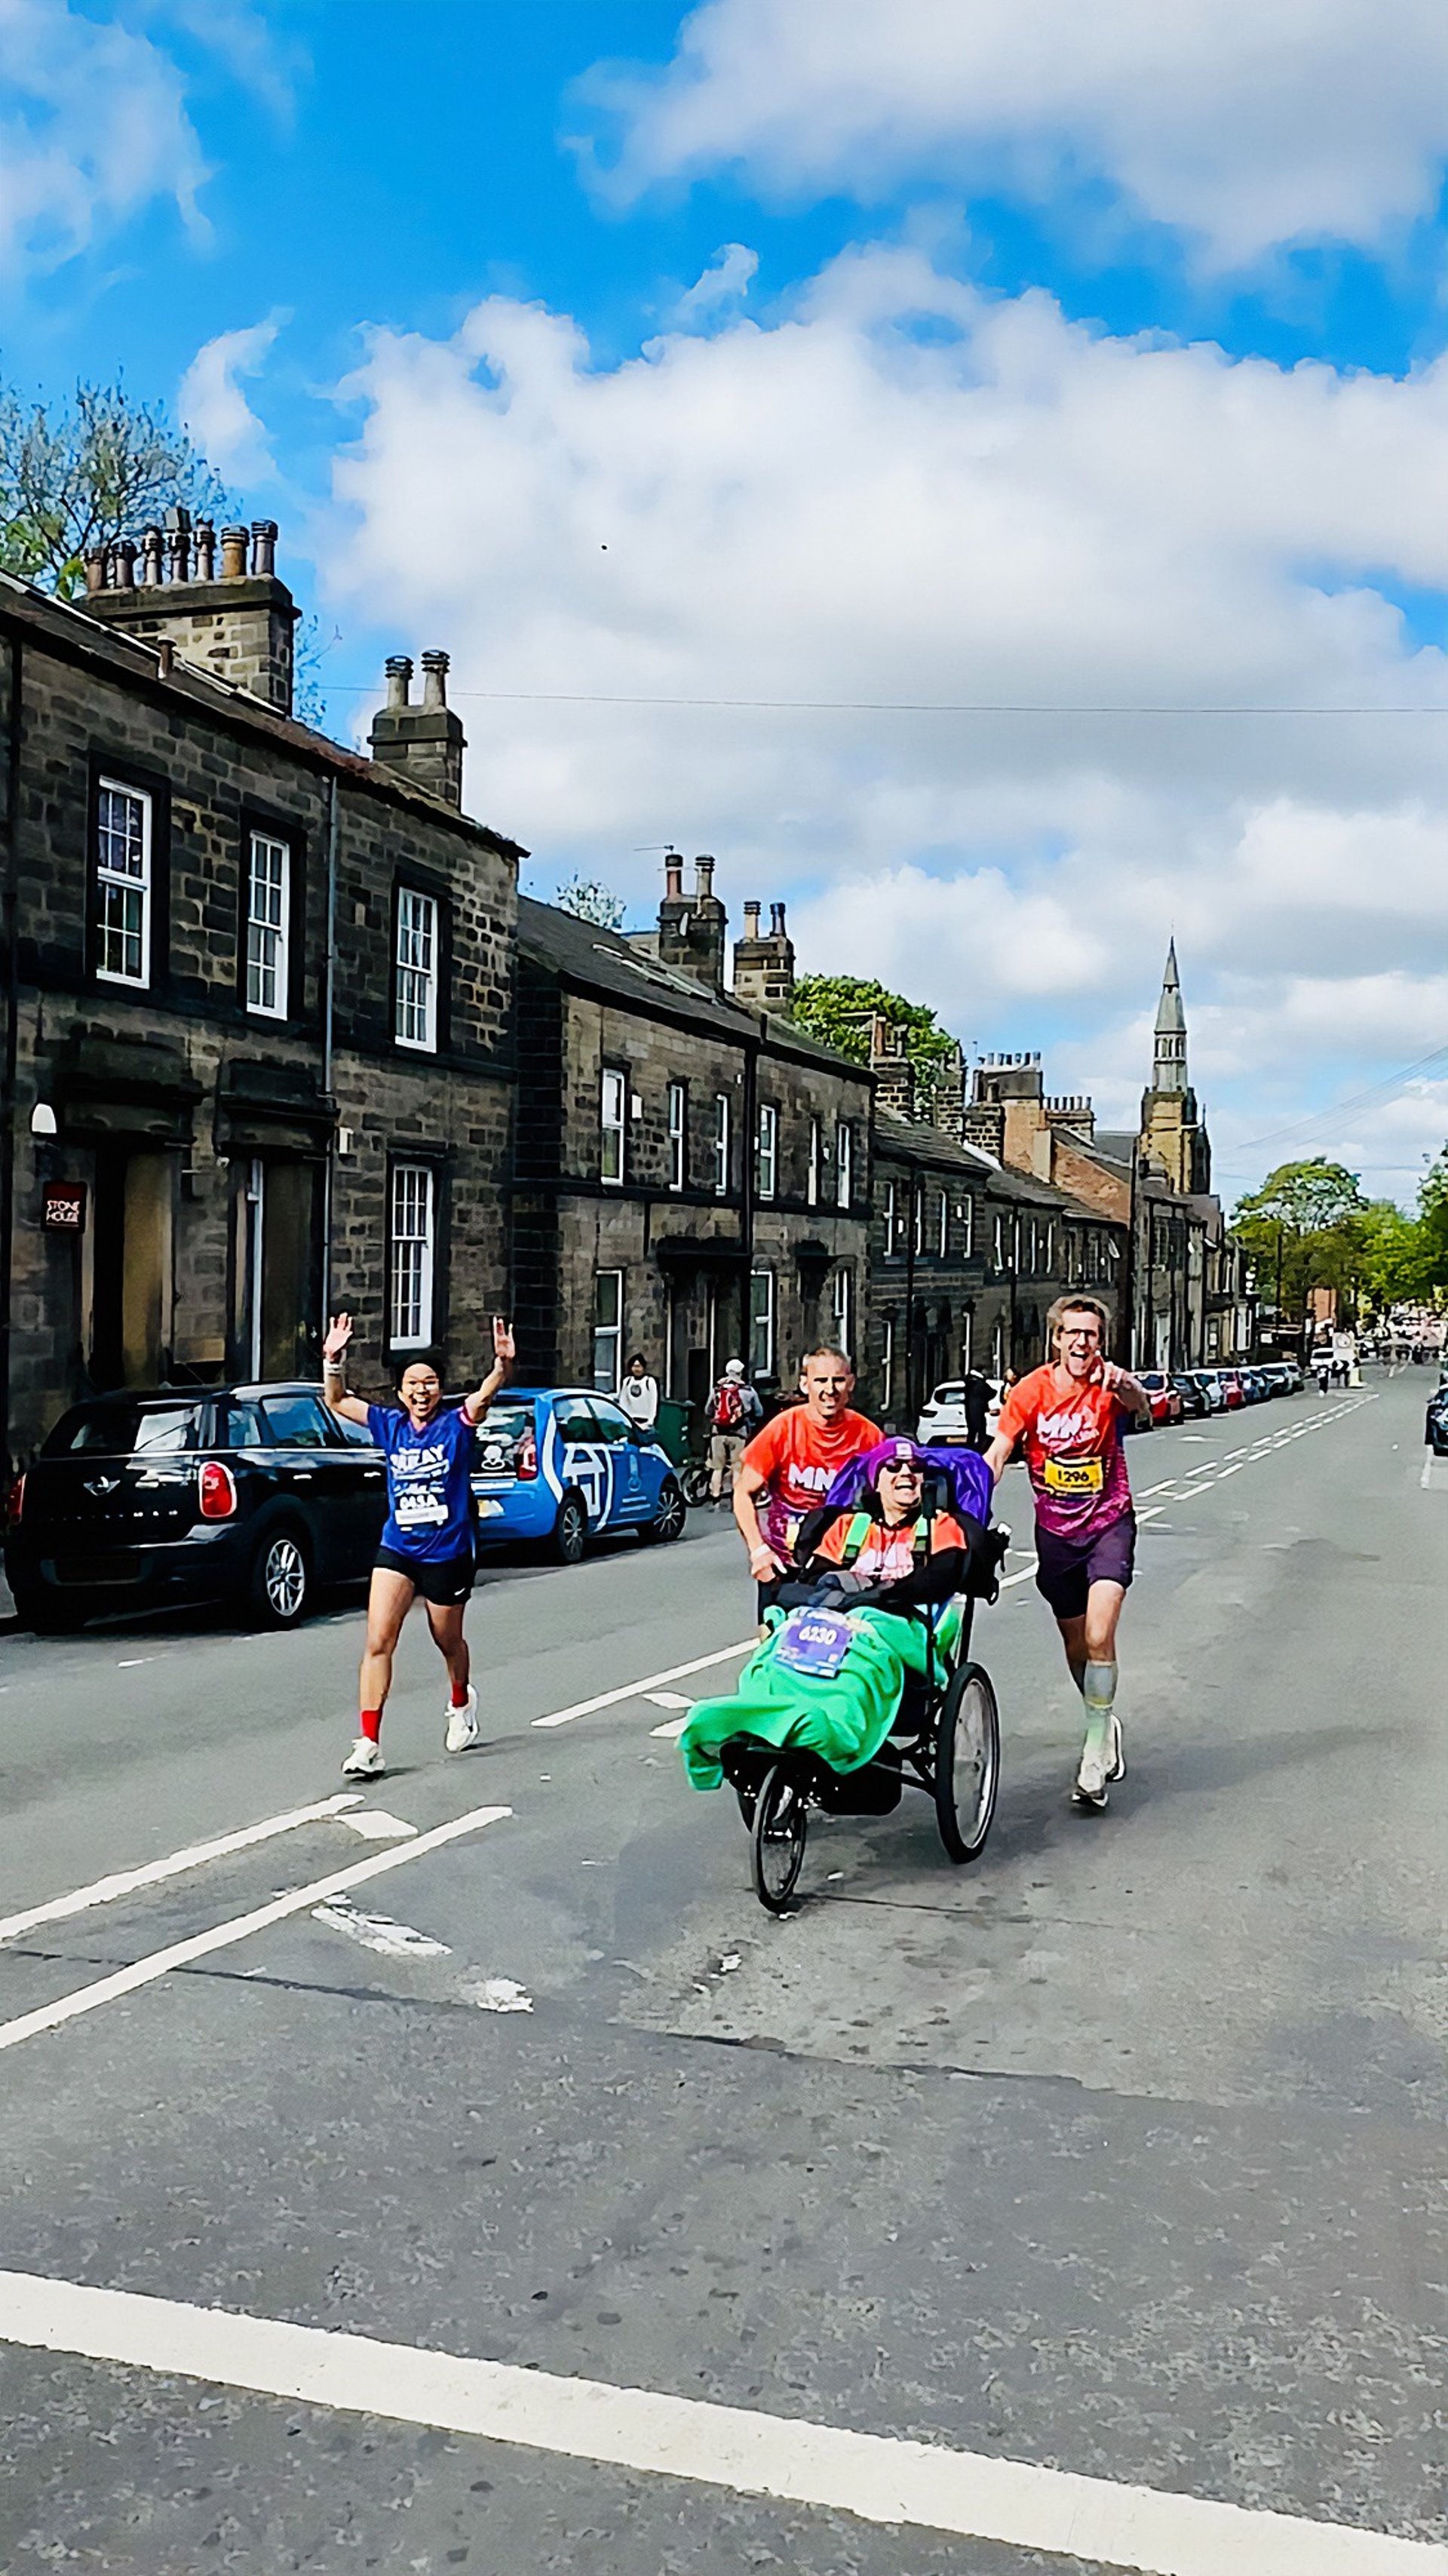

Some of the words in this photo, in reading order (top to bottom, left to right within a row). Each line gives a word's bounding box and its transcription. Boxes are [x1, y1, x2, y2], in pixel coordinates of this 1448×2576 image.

[47, 1199, 80, 1214] STONE
[45, 1210, 79, 1223] HOUSE
[1057, 1469, 1090, 1483] 1296
[798, 1626, 838, 1646] 6230
